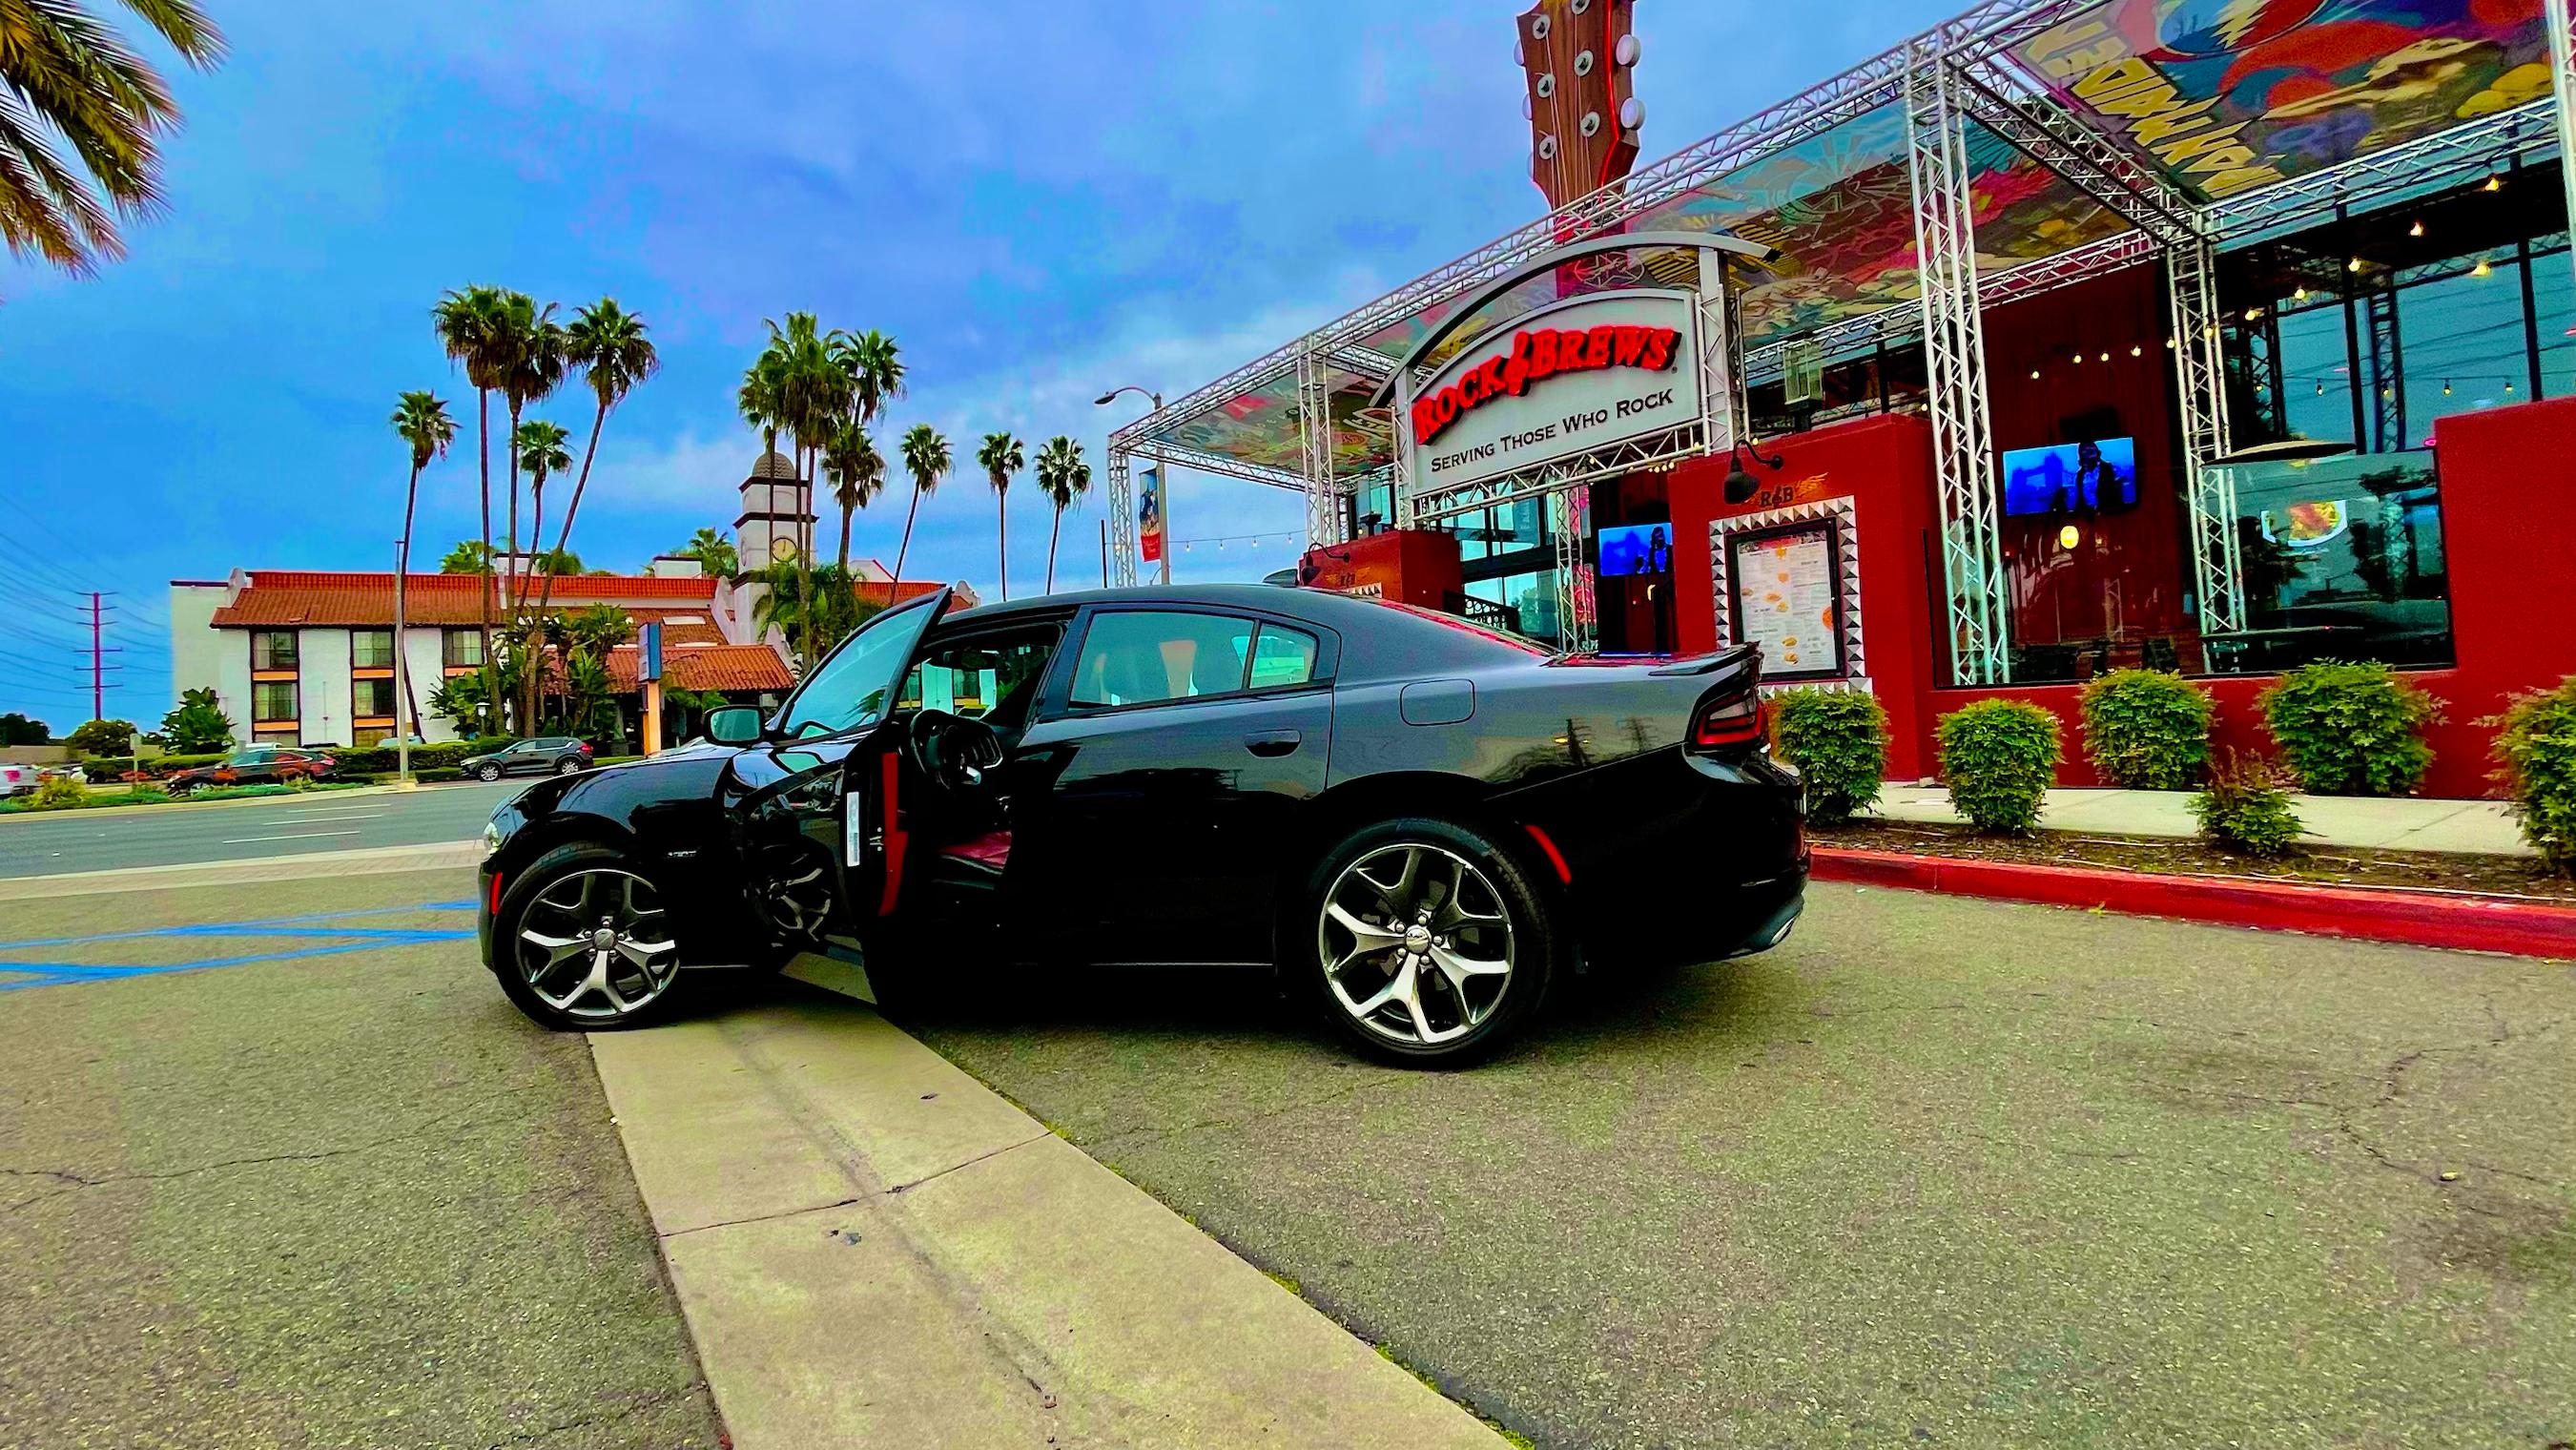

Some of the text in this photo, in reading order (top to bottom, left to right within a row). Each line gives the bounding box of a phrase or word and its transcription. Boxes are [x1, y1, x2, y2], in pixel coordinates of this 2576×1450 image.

[1412, 355, 1506, 445] ROCK
[1526, 323, 1678, 379] BREWS
[1431, 388, 1674, 472] SERVING THOSE WHO ROCK
